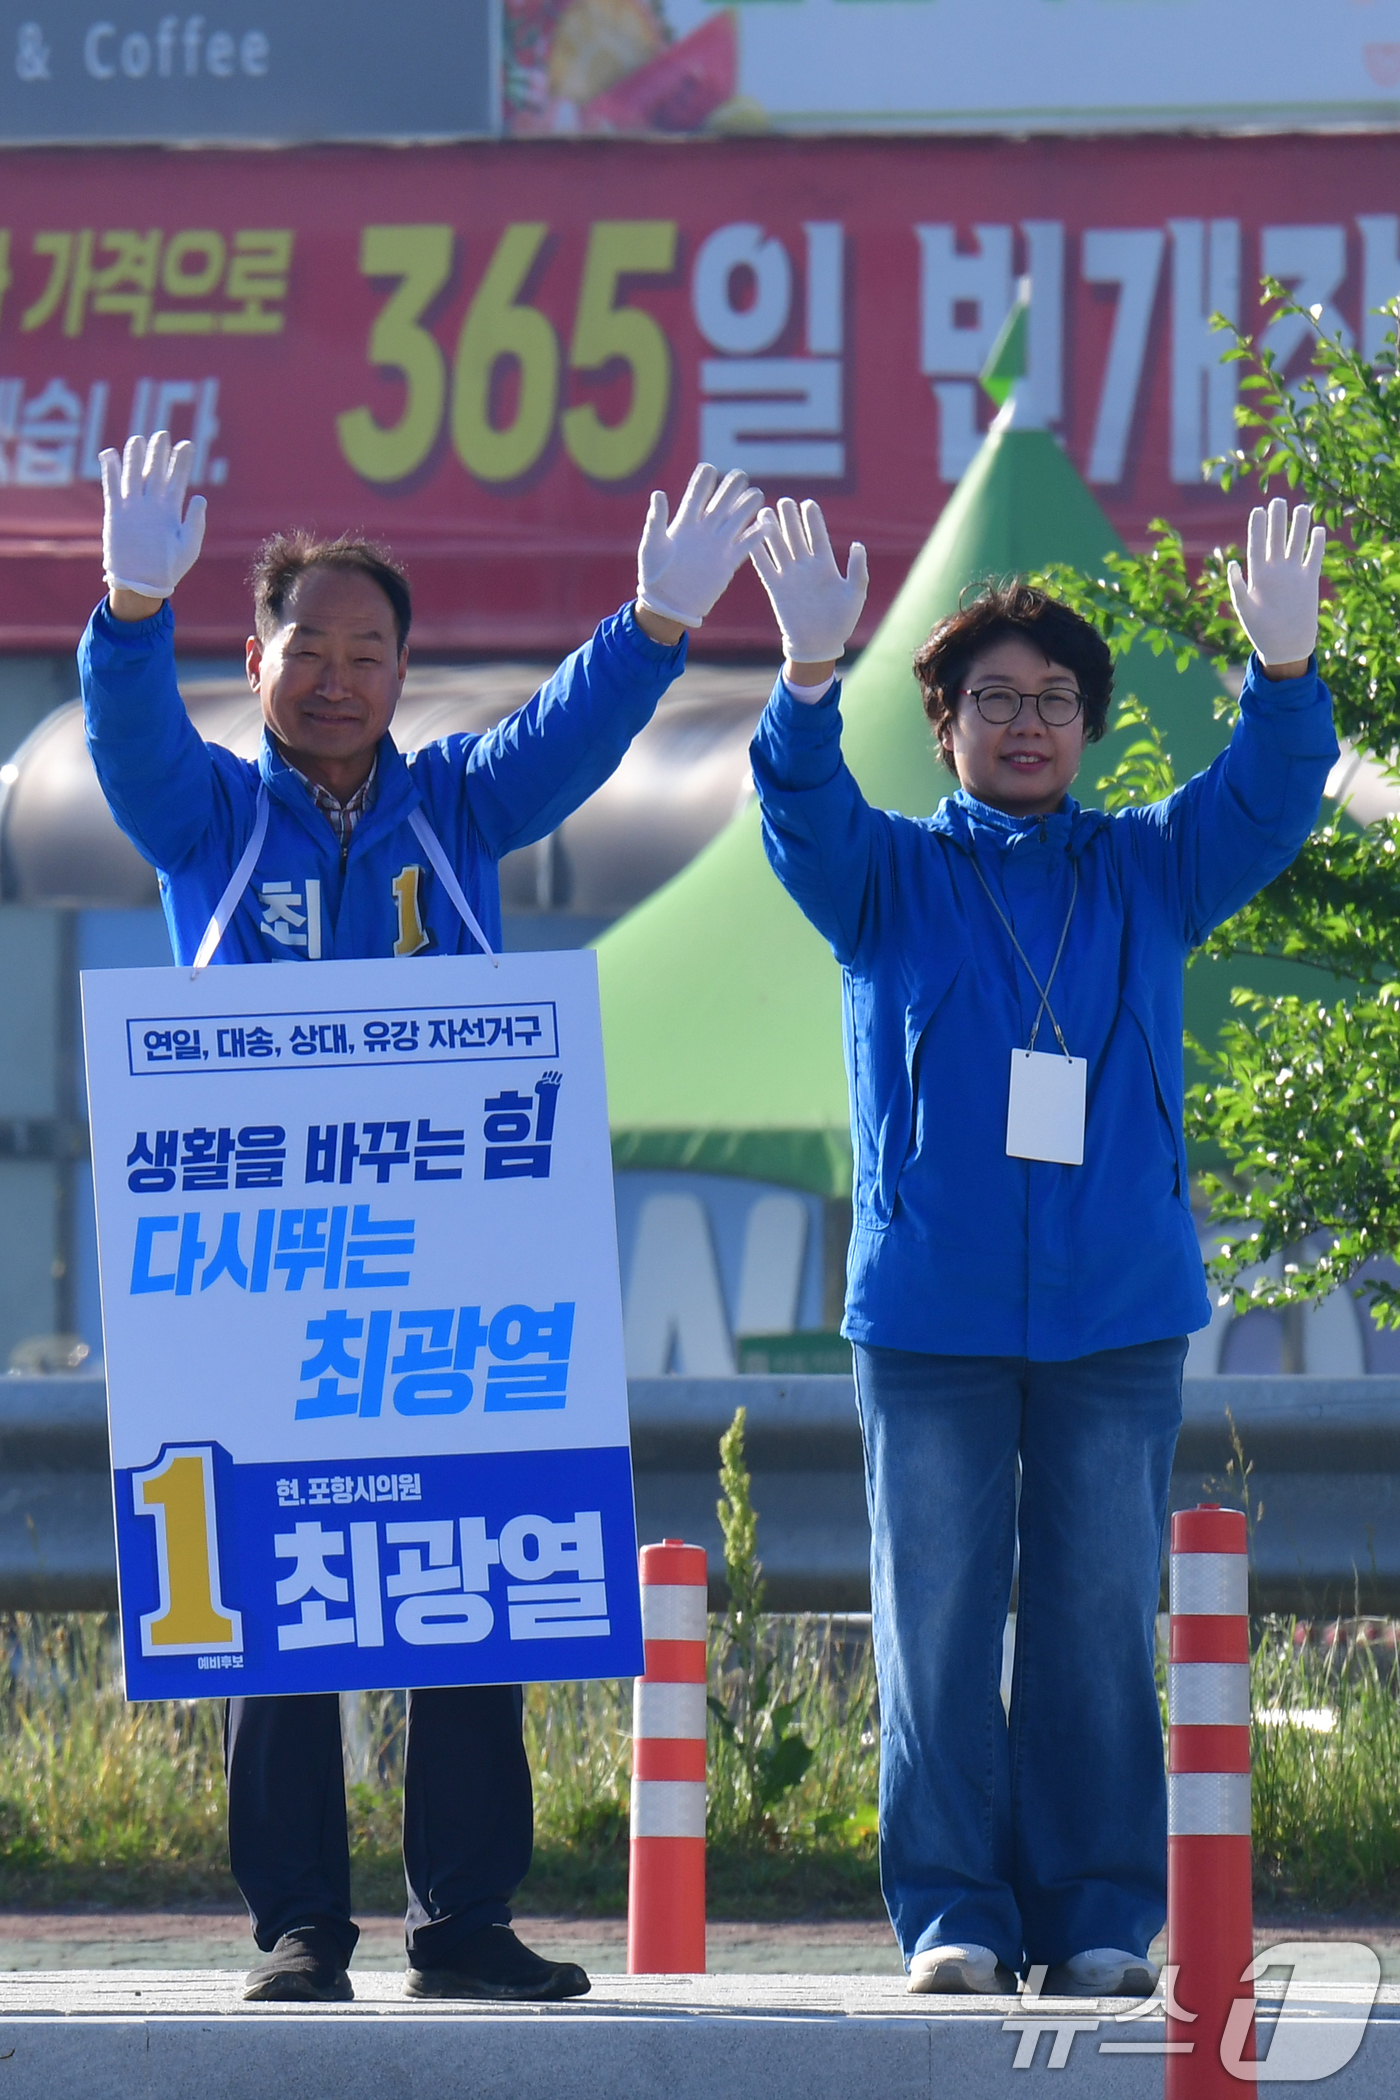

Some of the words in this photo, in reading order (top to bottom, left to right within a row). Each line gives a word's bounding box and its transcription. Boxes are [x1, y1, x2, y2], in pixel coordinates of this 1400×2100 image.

[15, 22, 51, 82] &
[83, 17, 270, 79] Coffee
[20, 229, 294, 338] 가격으로
[335, 218, 845, 486] 365일
[260, 878, 321, 959] 최
[392, 864, 430, 958] 1
[143, 1029, 209, 1062] 연일,
[216, 1026, 281, 1058] 대송,
[289, 1023, 355, 1055] 상대,
[363, 1020, 420, 1052] 유강
[428, 1015, 542, 1049] 자선거구
[126, 1123, 287, 1194] 생활을
[304, 1118, 466, 1185] 바꾸는
[483, 1070, 563, 1181] 힘
[129, 1203, 416, 1297] 다시뛰는
[294, 1301, 577, 1422] 최광열
[131, 1445, 245, 1657] 1
[273, 1510, 612, 1652] 최광열
[197, 1654, 245, 1670] 예비후보
